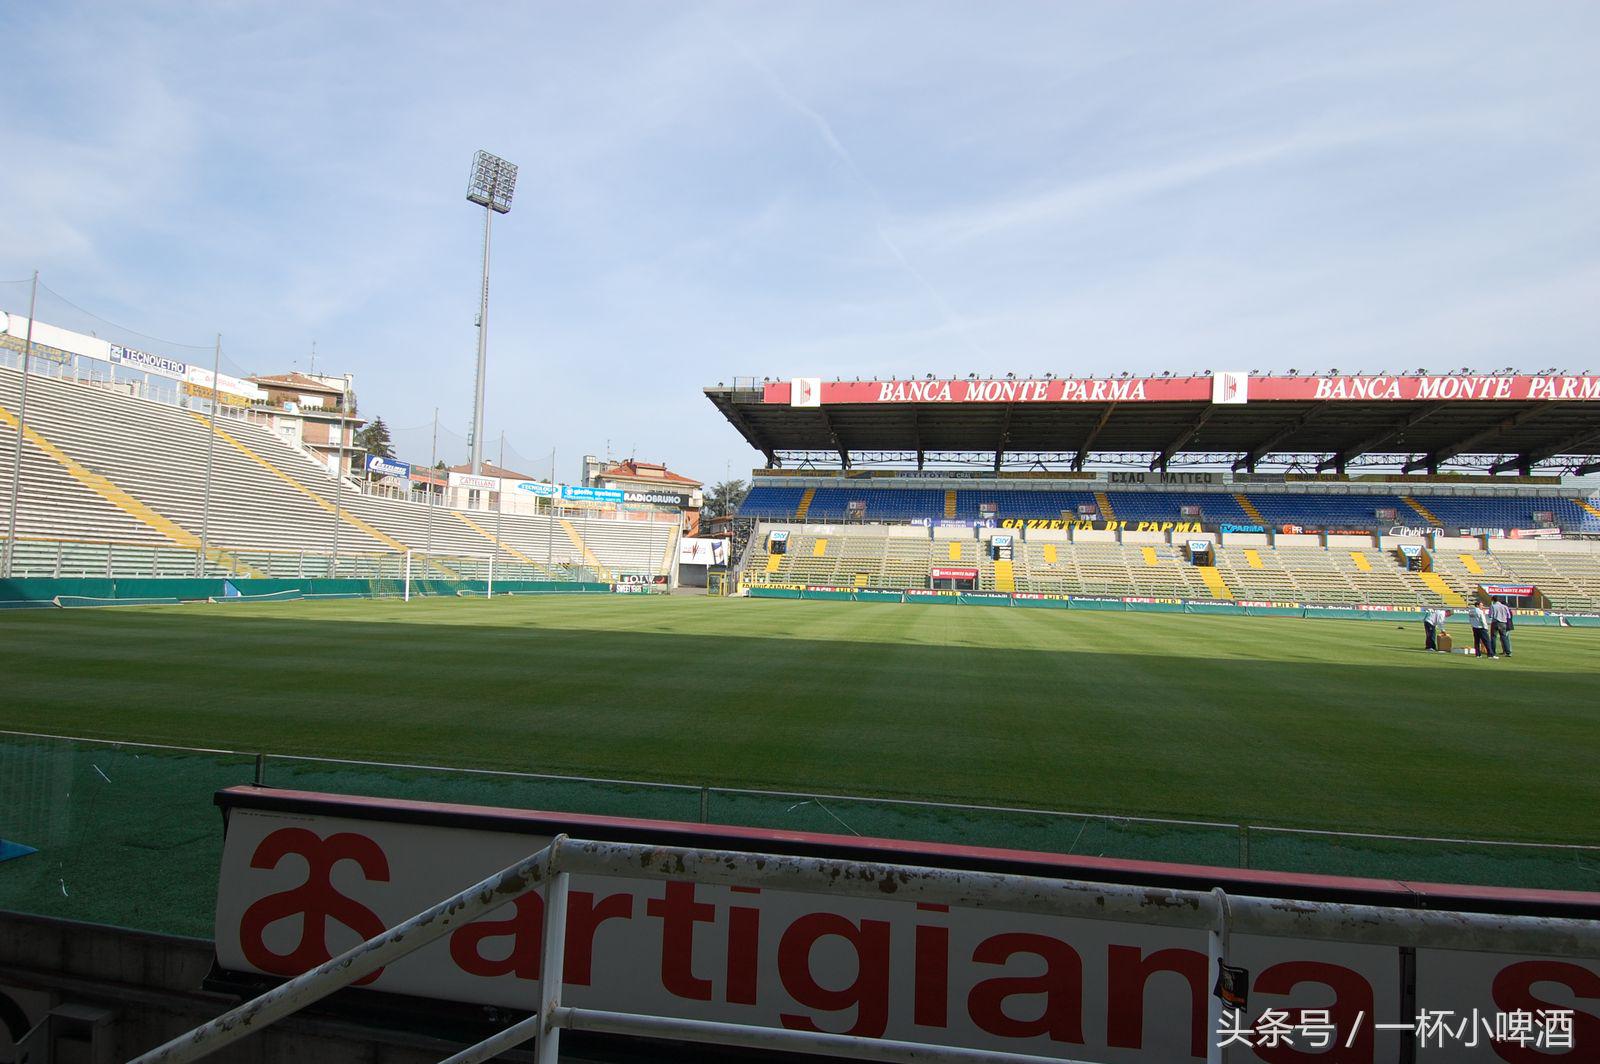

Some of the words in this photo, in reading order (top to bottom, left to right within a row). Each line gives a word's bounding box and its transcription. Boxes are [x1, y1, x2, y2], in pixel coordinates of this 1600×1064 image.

[125, 348, 184, 373] TECNOVETRO
[878, 381, 953, 402] BANCA
[964, 380, 1049, 402] MONTE
[1061, 380, 1147, 402] PARMA
[1314, 378, 1402, 400] BANCA
[1416, 378, 1513, 400] MONTE
[1111, 472, 1145, 484] CIAO
[1160, 472, 1212, 484] MATTEO
[624, 493, 681, 504] RADIOBRUNO
[1002, 519, 1093, 531] GAZZETTA
[1105, 520, 1127, 531] DI
